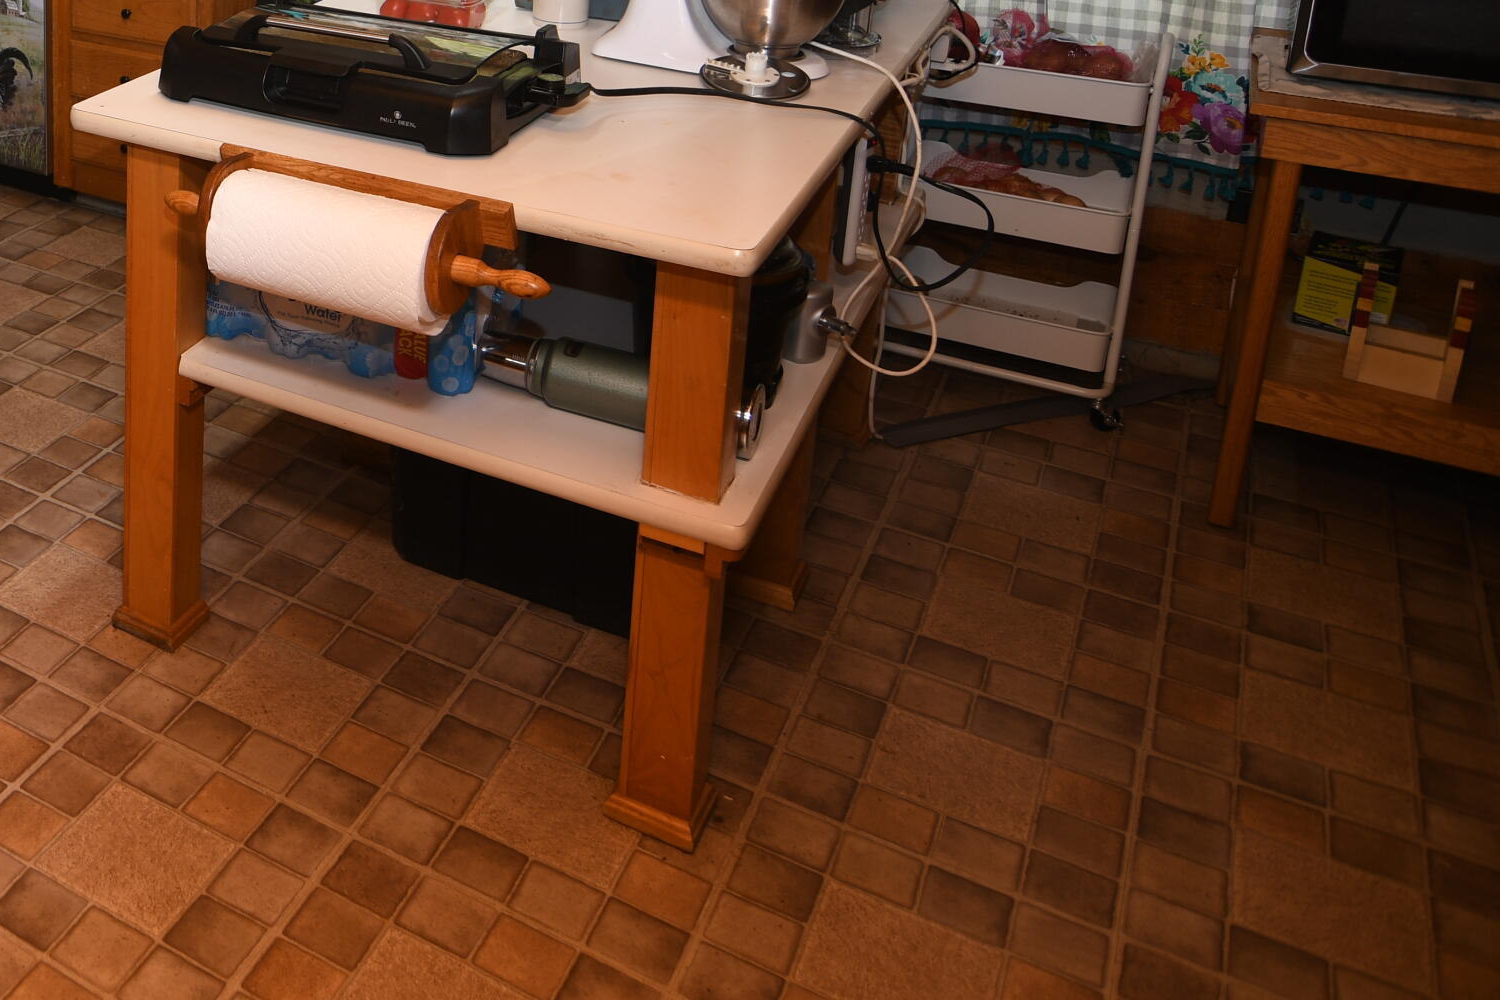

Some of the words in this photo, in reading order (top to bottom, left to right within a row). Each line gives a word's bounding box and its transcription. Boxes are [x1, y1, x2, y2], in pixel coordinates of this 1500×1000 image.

[304, 302, 342, 323] Water
[399, 329, 413, 358] ACK
[413, 331, 428, 365] ALUE
